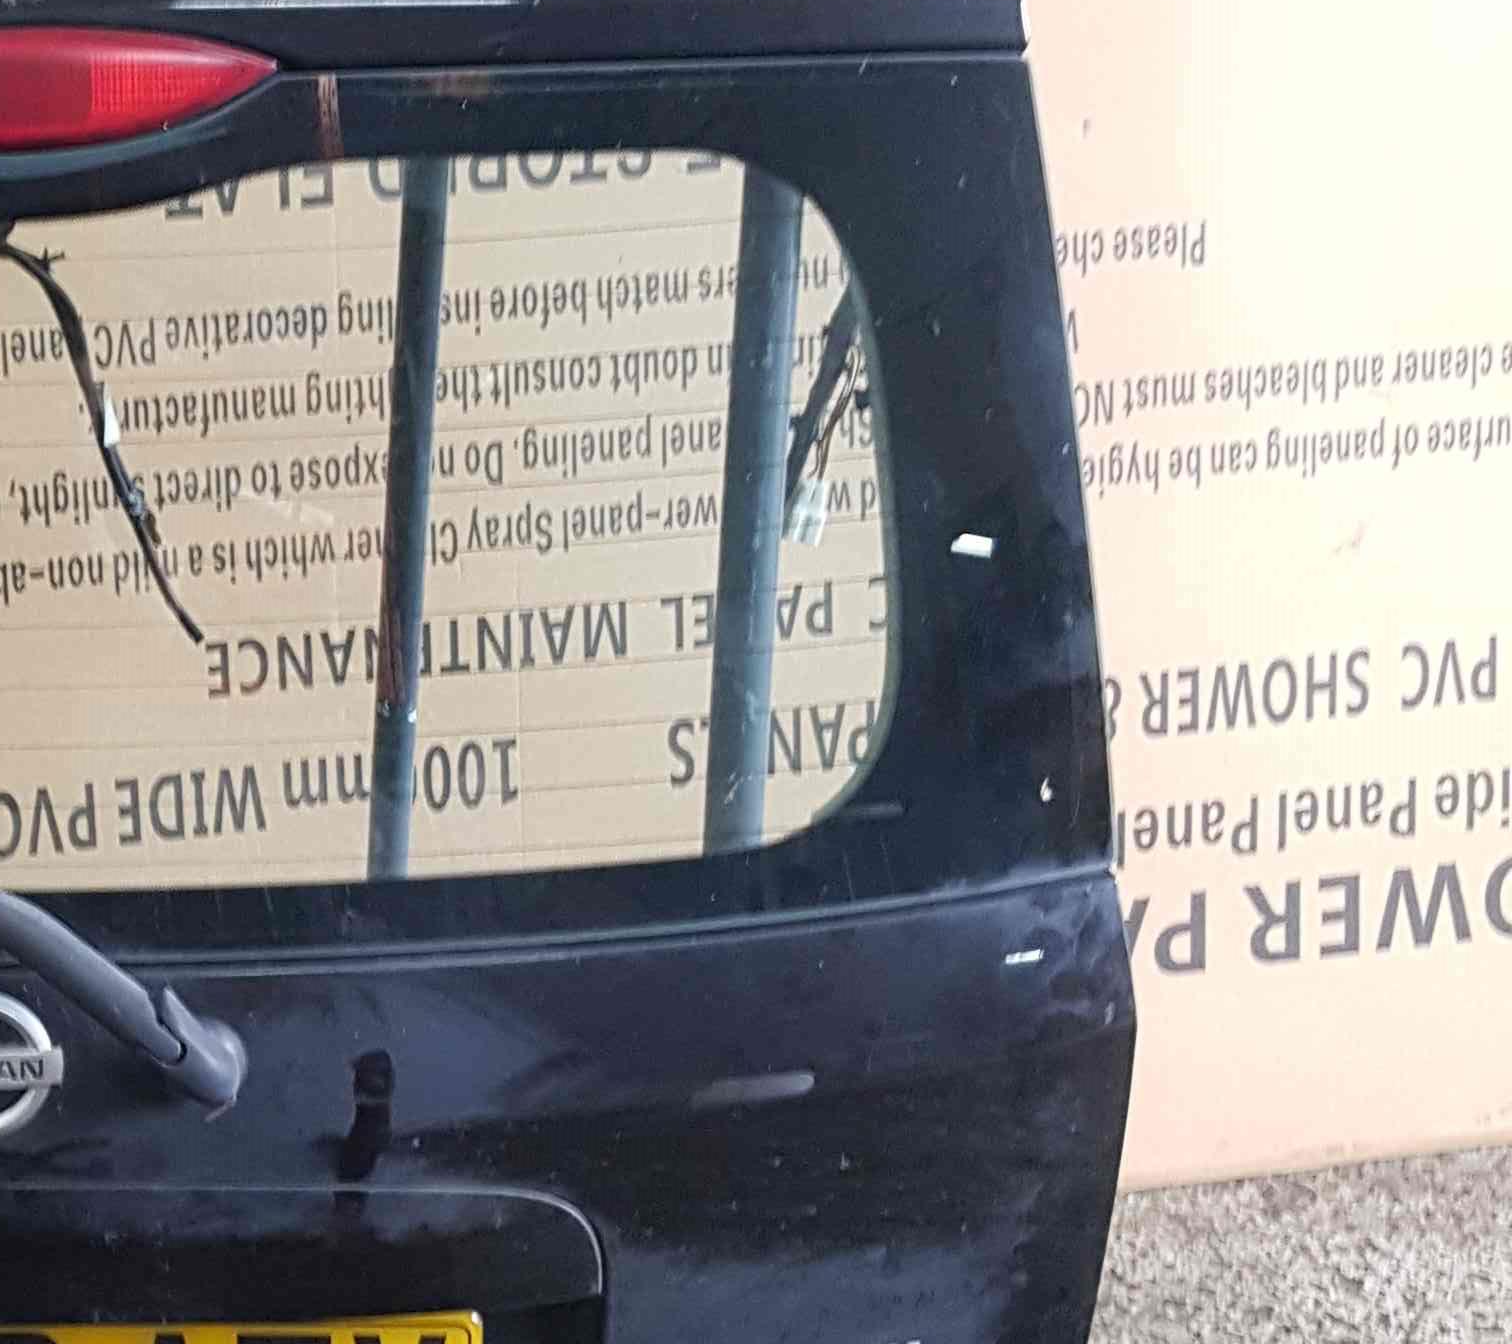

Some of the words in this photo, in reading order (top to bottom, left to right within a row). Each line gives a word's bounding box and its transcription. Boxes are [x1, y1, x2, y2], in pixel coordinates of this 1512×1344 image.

[1056, 229, 1105, 278] che
[1114, 220, 1206, 268] Please
[337, 290, 482, 345] insling
[489, 278, 587, 331] before
[594, 263, 688, 321] match
[94, 317, 156, 370] PVC
[166, 305, 329, 362] decorative
[489, 355, 602, 410] consult
[610, 347, 698, 396] doubt
[1204, 357, 1327, 411] bleaches
[1335, 354, 1384, 403] and
[1390, 343, 1493, 390] cleaner
[79, 382, 297, 439] manufactur.
[305, 371, 385, 425] hting
[1073, 381, 1114, 428] NO
[1123, 372, 1196, 416] must
[464, 441, 502, 485] Do
[514, 414, 651, 479] paneling.
[662, 421, 721, 469] anel
[1211, 439, 1257, 476] can
[1267, 418, 1385, 478] paneling
[1390, 420, 1419, 470] of
[1428, 415, 1512, 462] urface
[153, 466, 241, 514] direct
[252, 462, 281, 502] to
[1082, 441, 1159, 500] hygie
[1169, 446, 1201, 490] be
[10, 471, 143, 533] nlight,
[562, 492, 719, 553] wer-panel
[345, 522, 458, 568] Cler
[468, 503, 552, 555] Spray
[189, 543, 202, 577] a
[213, 541, 235, 585] is
[246, 533, 334, 584] which
[660, 581, 833, 651] PAEL
[1139, 649, 1370, 738] SHOWER
[1400, 633, 1498, 710] PVC
[668, 700, 876, 788] PANS
[115, 767, 267, 848] WIDE
[1277, 777, 1418, 853] Panel
[1435, 767, 1512, 831] ide
